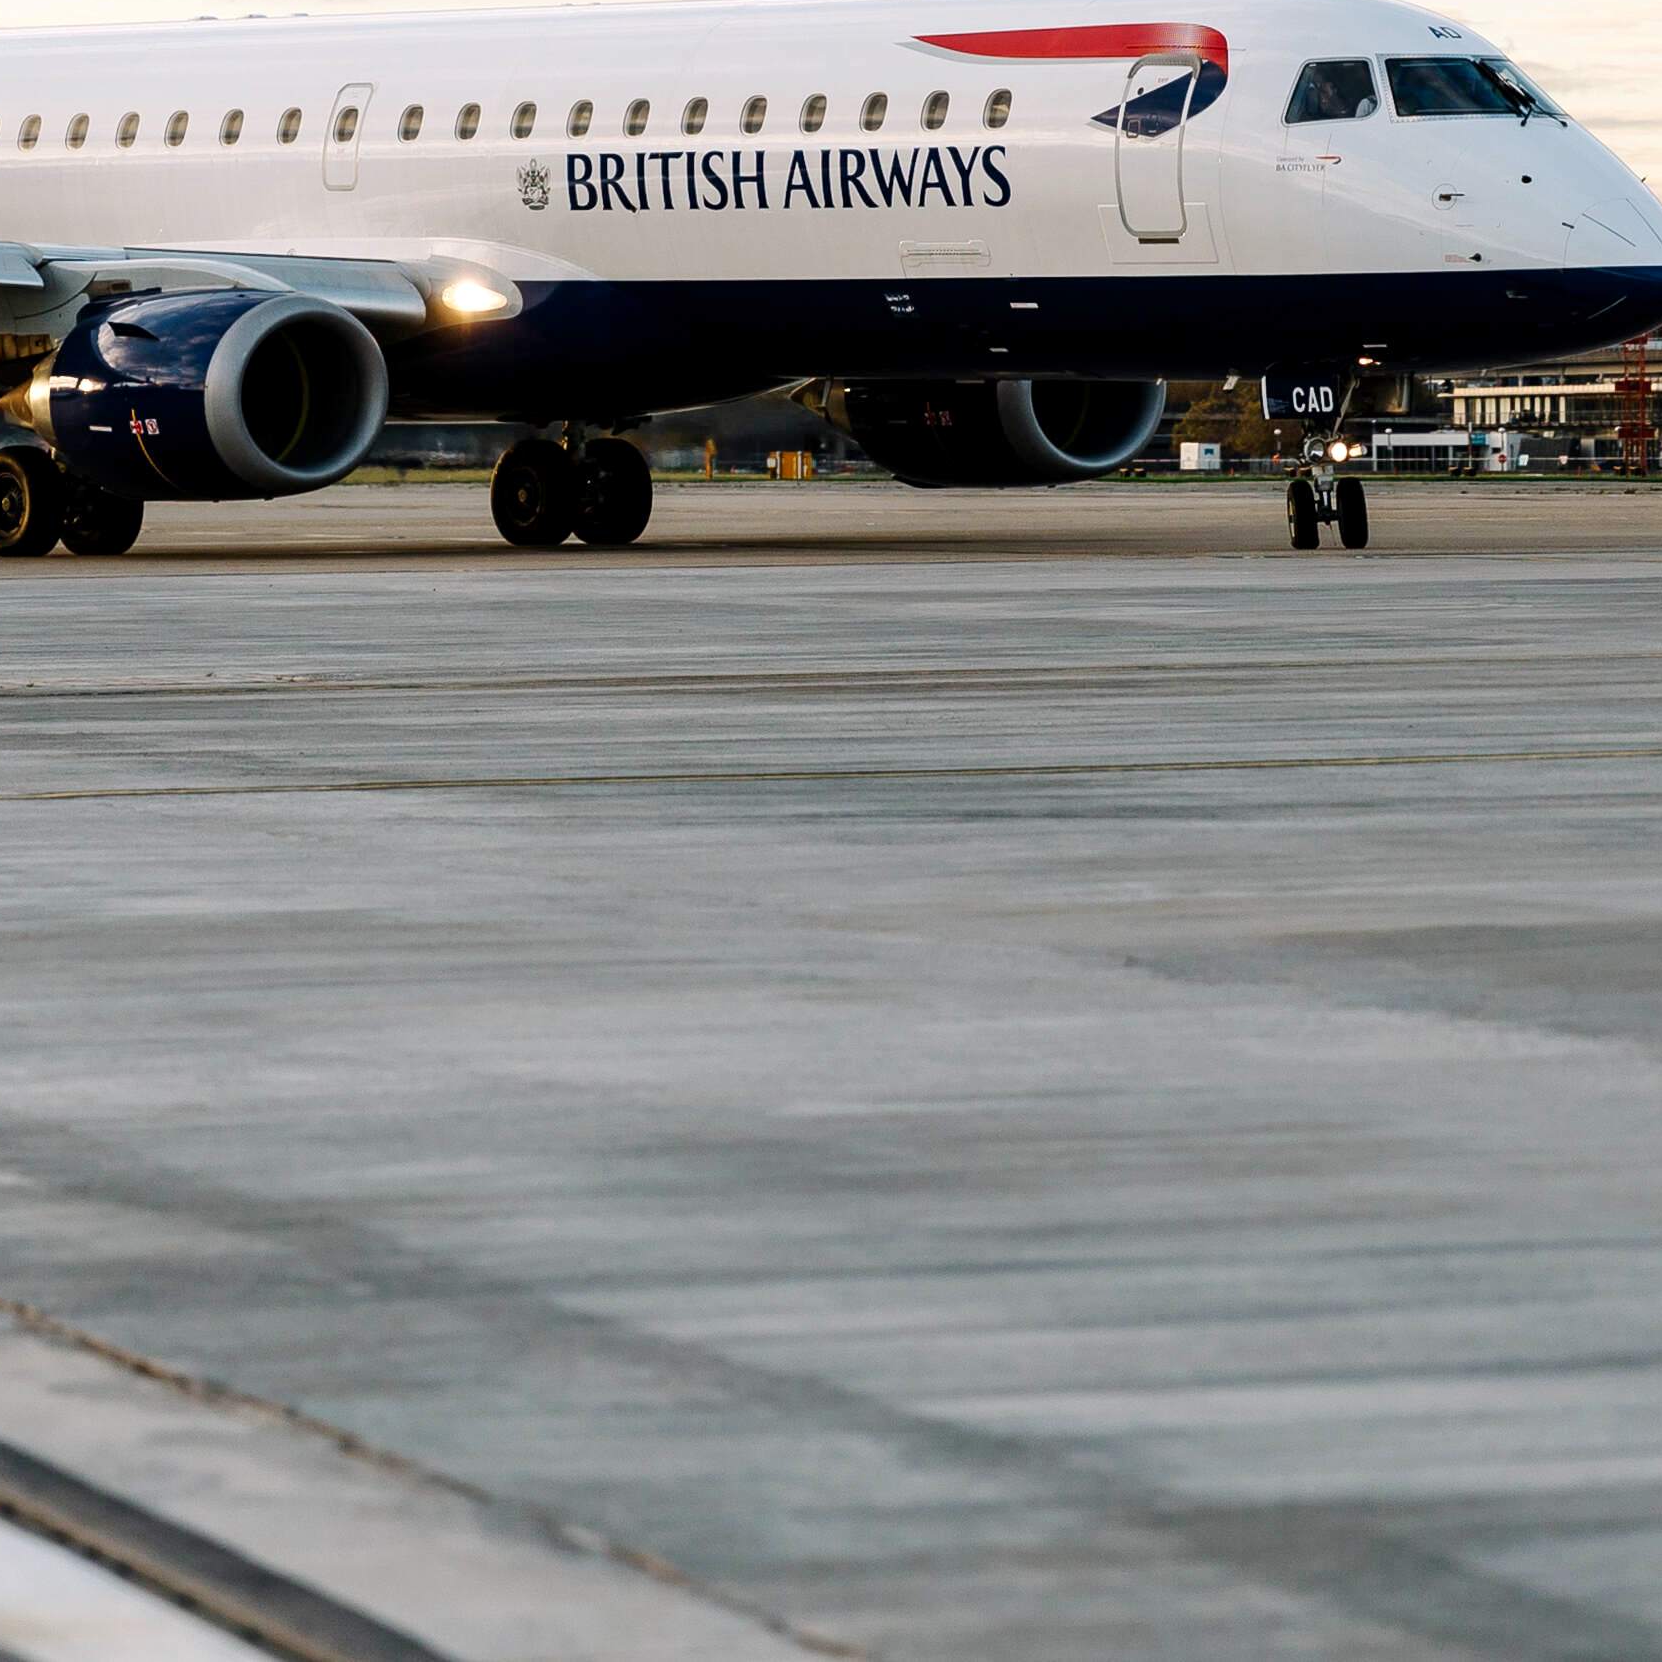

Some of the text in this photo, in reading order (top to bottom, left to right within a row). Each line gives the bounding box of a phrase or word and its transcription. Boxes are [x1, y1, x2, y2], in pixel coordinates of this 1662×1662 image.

[1427, 25, 1463, 39] AD
[565, 145, 1012, 213] BRITISH AIRWAYS
[1292, 386, 1334, 413] CAD
